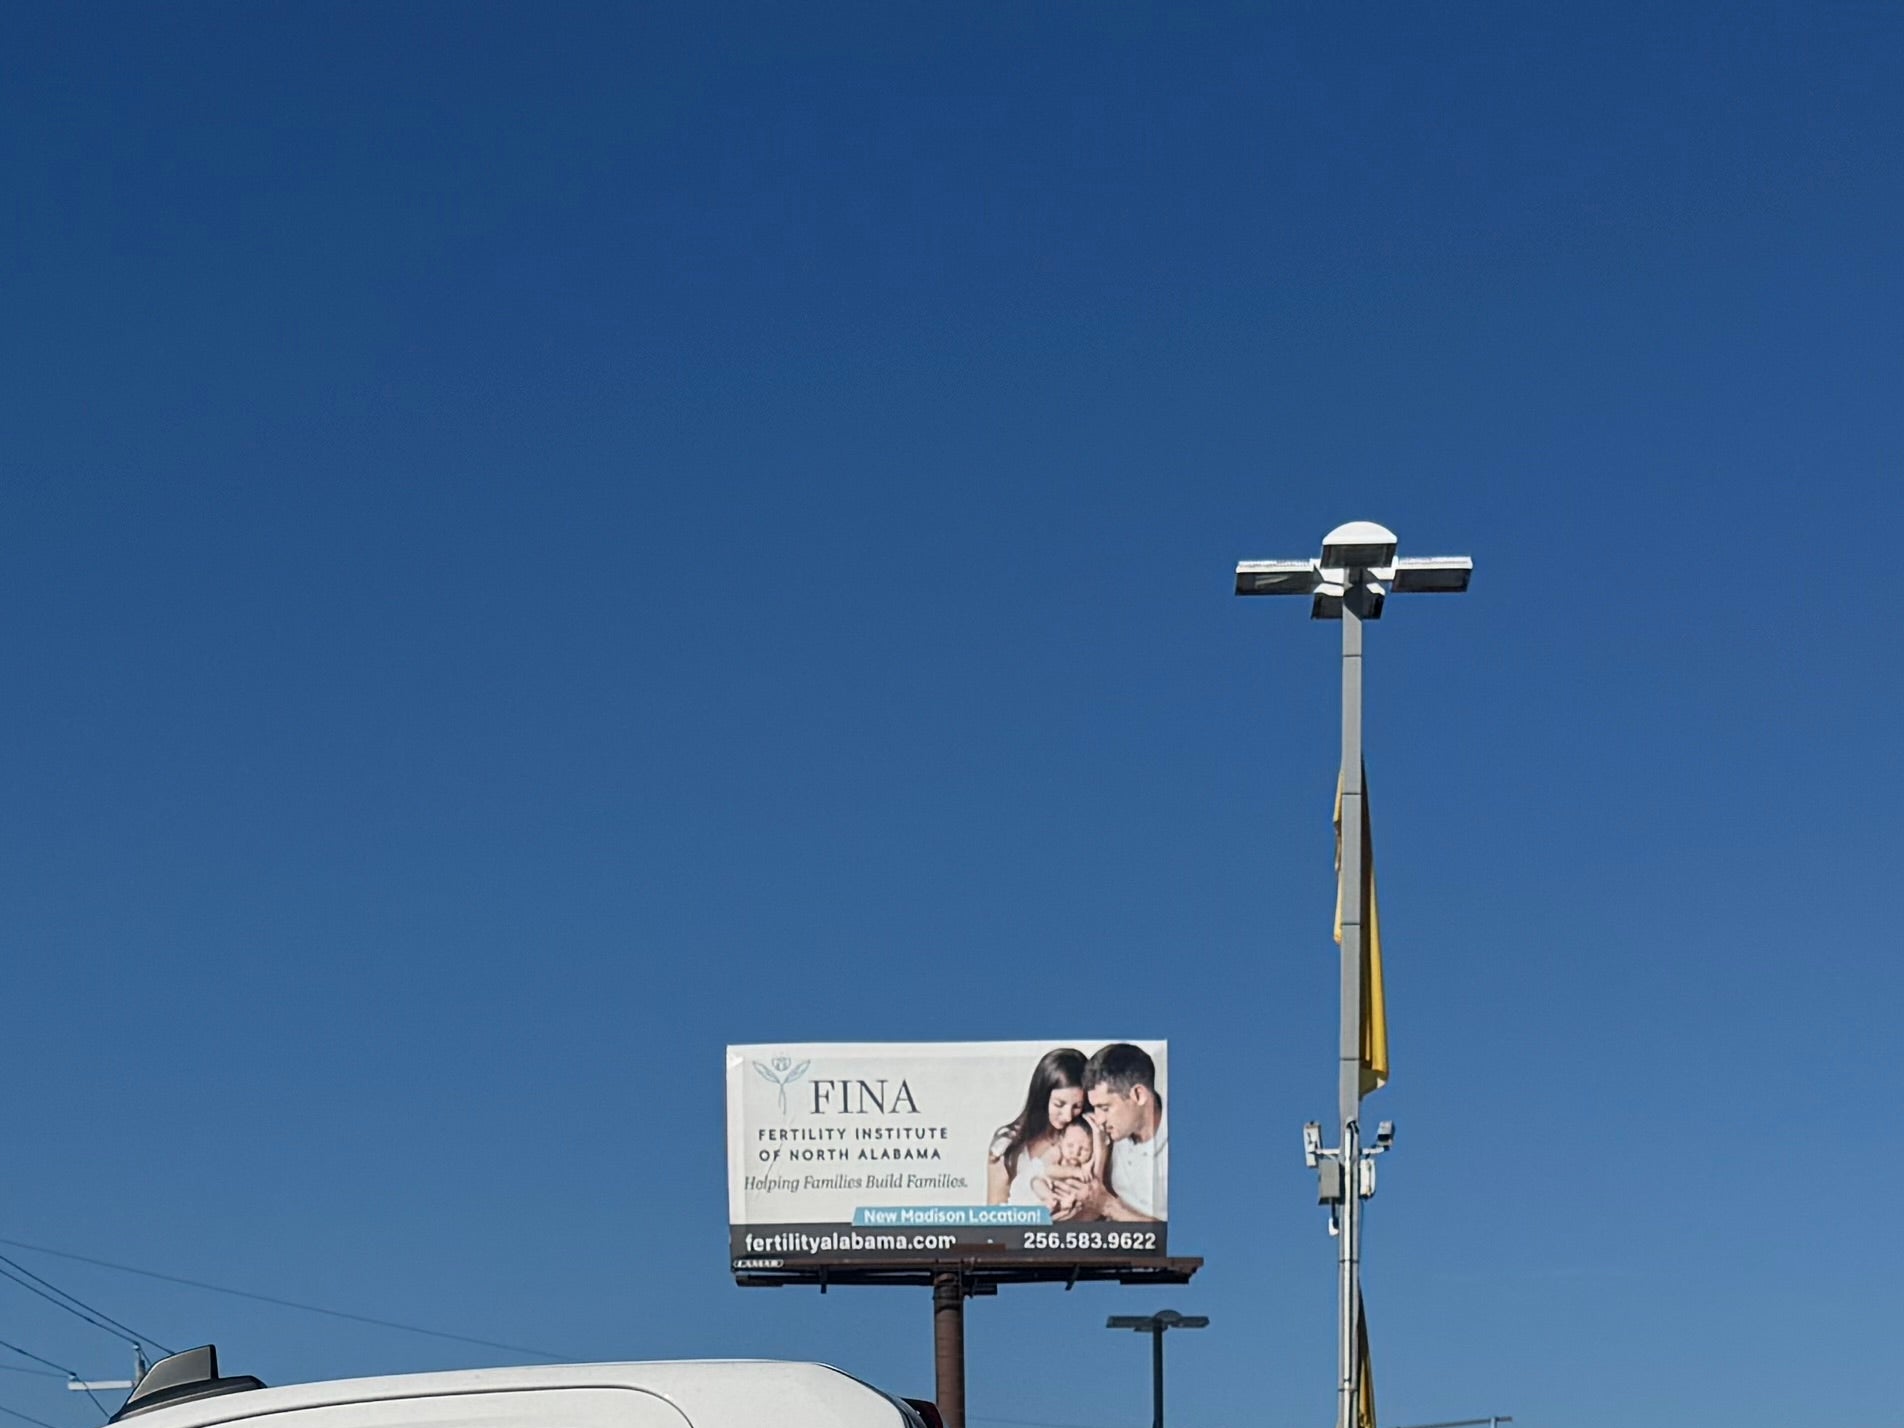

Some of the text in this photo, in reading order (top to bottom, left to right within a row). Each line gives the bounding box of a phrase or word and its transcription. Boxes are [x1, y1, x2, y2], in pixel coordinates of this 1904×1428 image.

[809, 1078, 921, 1115] FINA
[758, 1127, 948, 1141] FERTILITY INSTITUTE
[758, 1148, 942, 1162] OF NORTH ALABAMA
[744, 1173, 969, 1193] Helping Families Build Families.
[864, 1208, 1041, 1224] New Madison Location!
[745, 1232, 956, 1254] fertilityalabama.com
[1023, 1232, 1157, 1250] 256.583.9622
